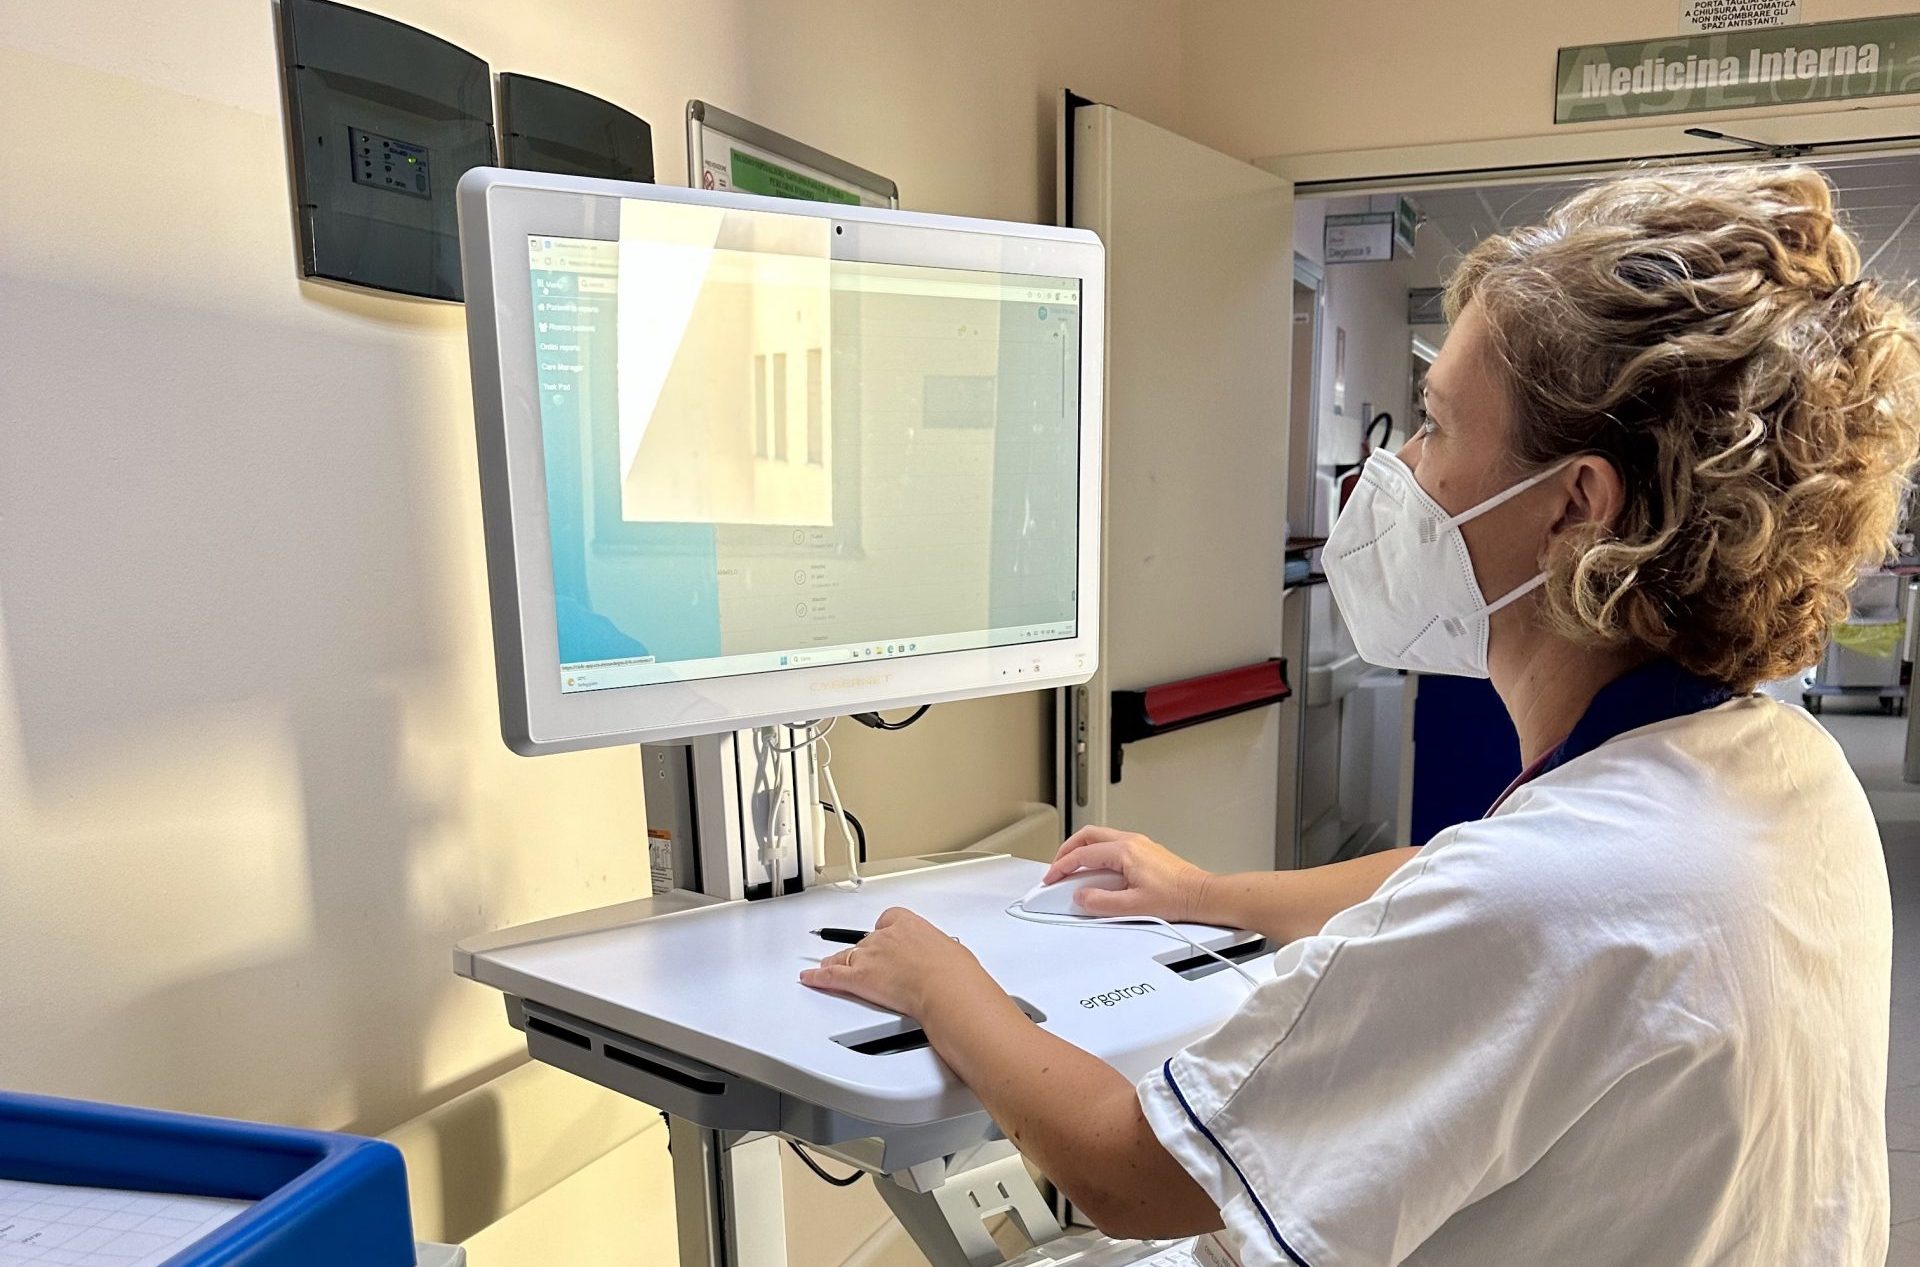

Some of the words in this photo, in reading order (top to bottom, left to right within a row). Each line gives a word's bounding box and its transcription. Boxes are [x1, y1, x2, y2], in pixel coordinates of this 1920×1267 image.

[1693, 6, 1737, 16] CHIUSURA
[1740, 0, 1796, 11] AUTOMATICA
[1695, 0, 1723, 8] PORTA
[1692, 16, 1711, 24] NON
[1712, 10, 1771, 21] INGOMBRARE
[1773, 8, 1789, 16] GLI
[1701, 22, 1726, 30] SPAZI
[1581, 54, 1740, 98] Medicina
[1747, 43, 1880, 84] Interna
[1080, 982, 1156, 1009] ergotron
